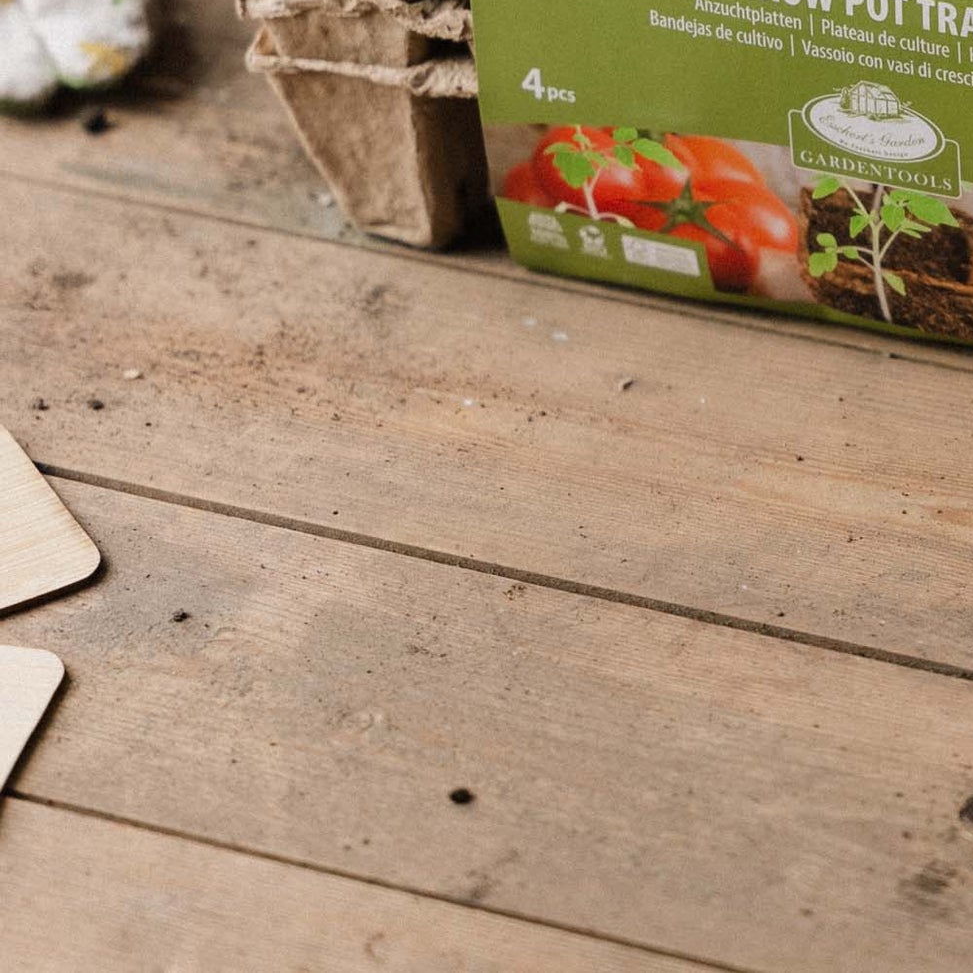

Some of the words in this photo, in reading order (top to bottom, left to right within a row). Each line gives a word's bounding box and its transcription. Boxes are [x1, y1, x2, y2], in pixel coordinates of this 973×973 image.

[649, 9, 712, 38] Bandejas
[716, 24, 733, 40] de
[736, 30, 783, 51] cultivo
[801, 39, 855, 64] Vassoio
[859, 55, 883, 69] con
[887, 59, 914, 75] vasi
[918, 62, 932, 78] di
[821, 19, 874, 44] Plateau
[878, 31, 896, 48] de
[900, 36, 950, 58] culture
[521, 67, 546, 100] 4
[547, 85, 577, 103] pcs
[800, 149, 953, 191] GARDENTOOLS
